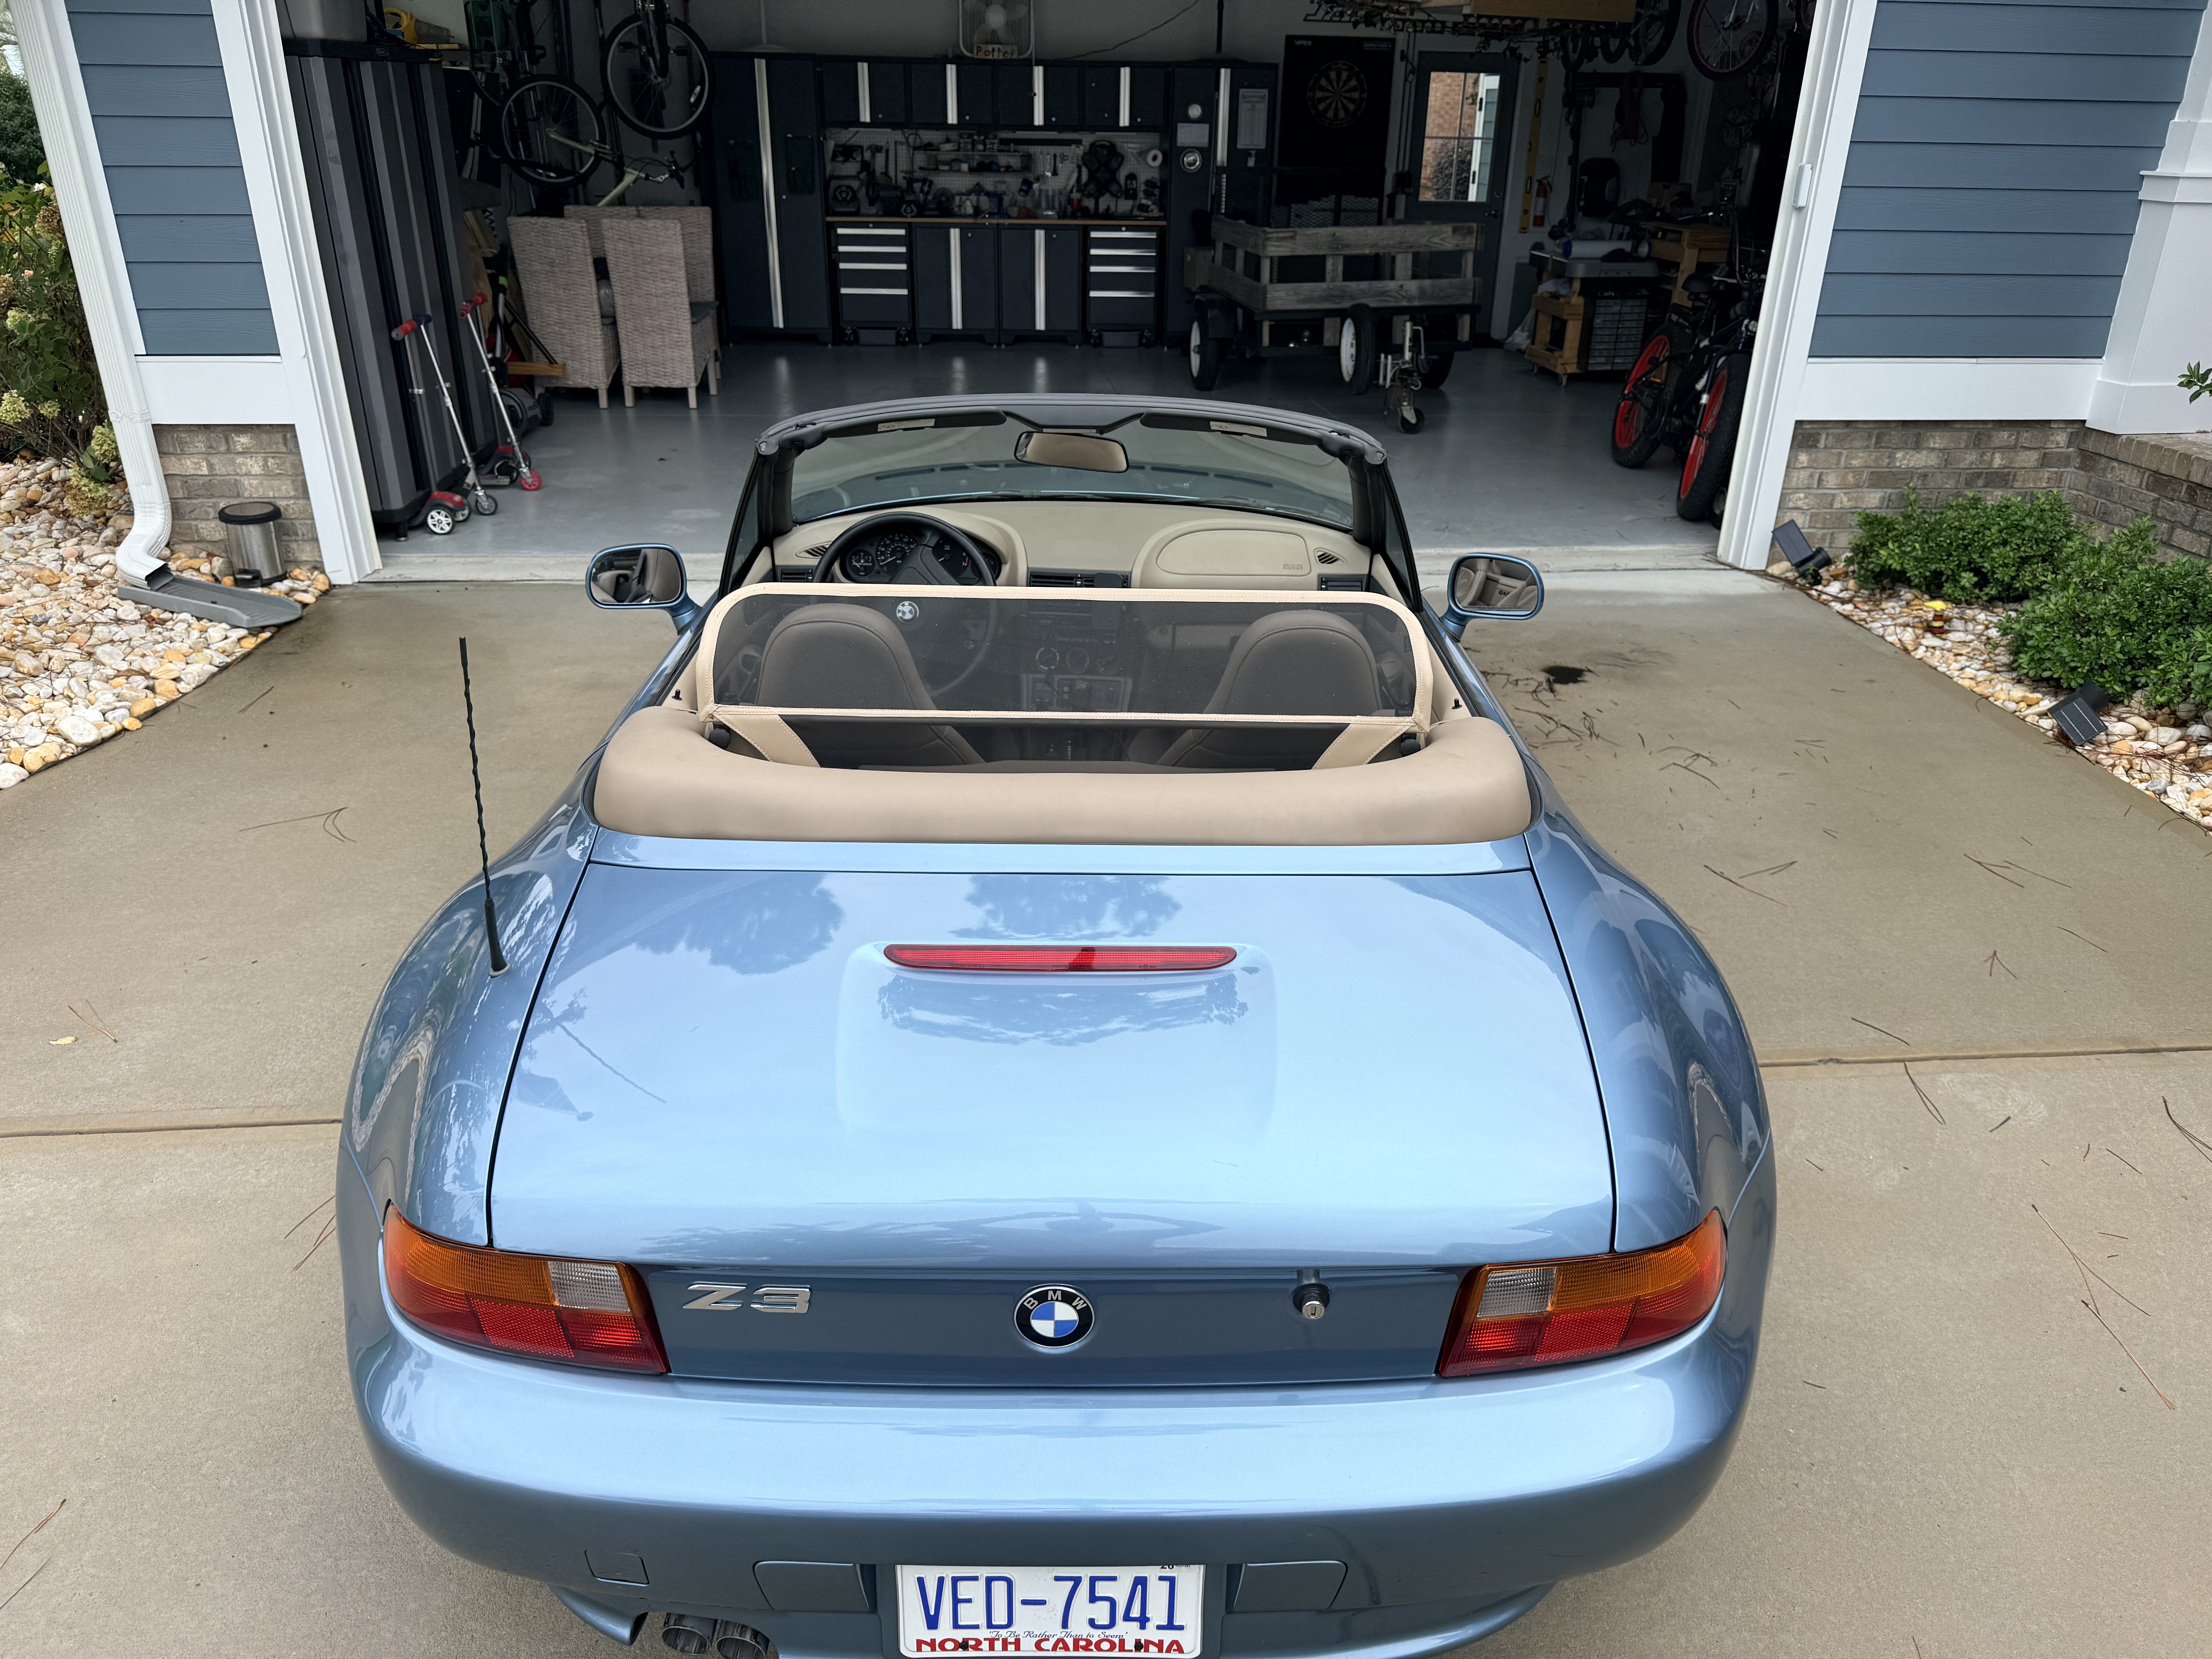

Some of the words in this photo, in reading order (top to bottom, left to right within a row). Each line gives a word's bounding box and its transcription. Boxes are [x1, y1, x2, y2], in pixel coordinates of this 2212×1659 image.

[683, 1281, 812, 1313] Z3
[1023, 1290, 1087, 1310] BMW
[917, 1575, 1185, 1630] VED-7541
[916, 1637, 1021, 1652] NORTH
[1034, 1638, 1185, 1654] CAROLINA
